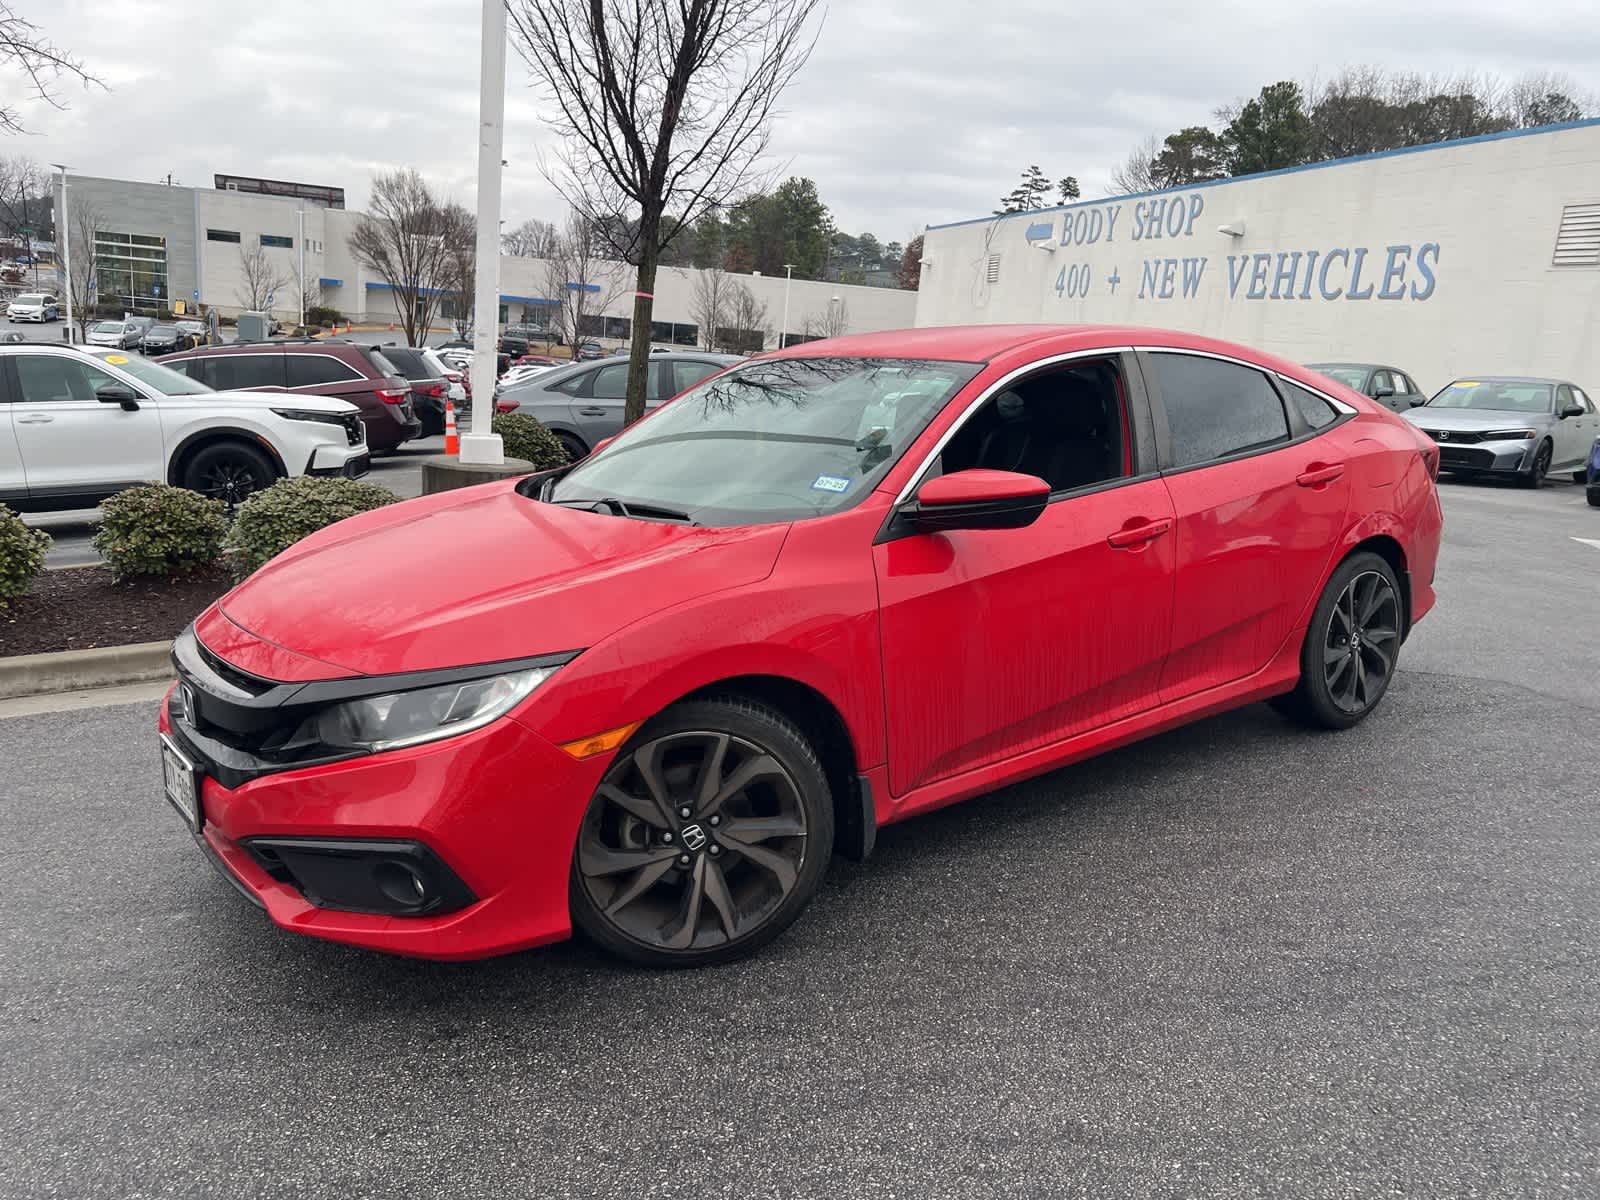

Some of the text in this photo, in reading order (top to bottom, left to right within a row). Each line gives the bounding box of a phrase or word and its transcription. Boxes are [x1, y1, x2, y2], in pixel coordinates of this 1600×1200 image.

[1060, 194, 1204, 247] BODY SHOP
[1055, 263, 1091, 298] 400
[1138, 257, 1208, 299] NEW
[1226, 242, 1441, 301] VEHICLES
